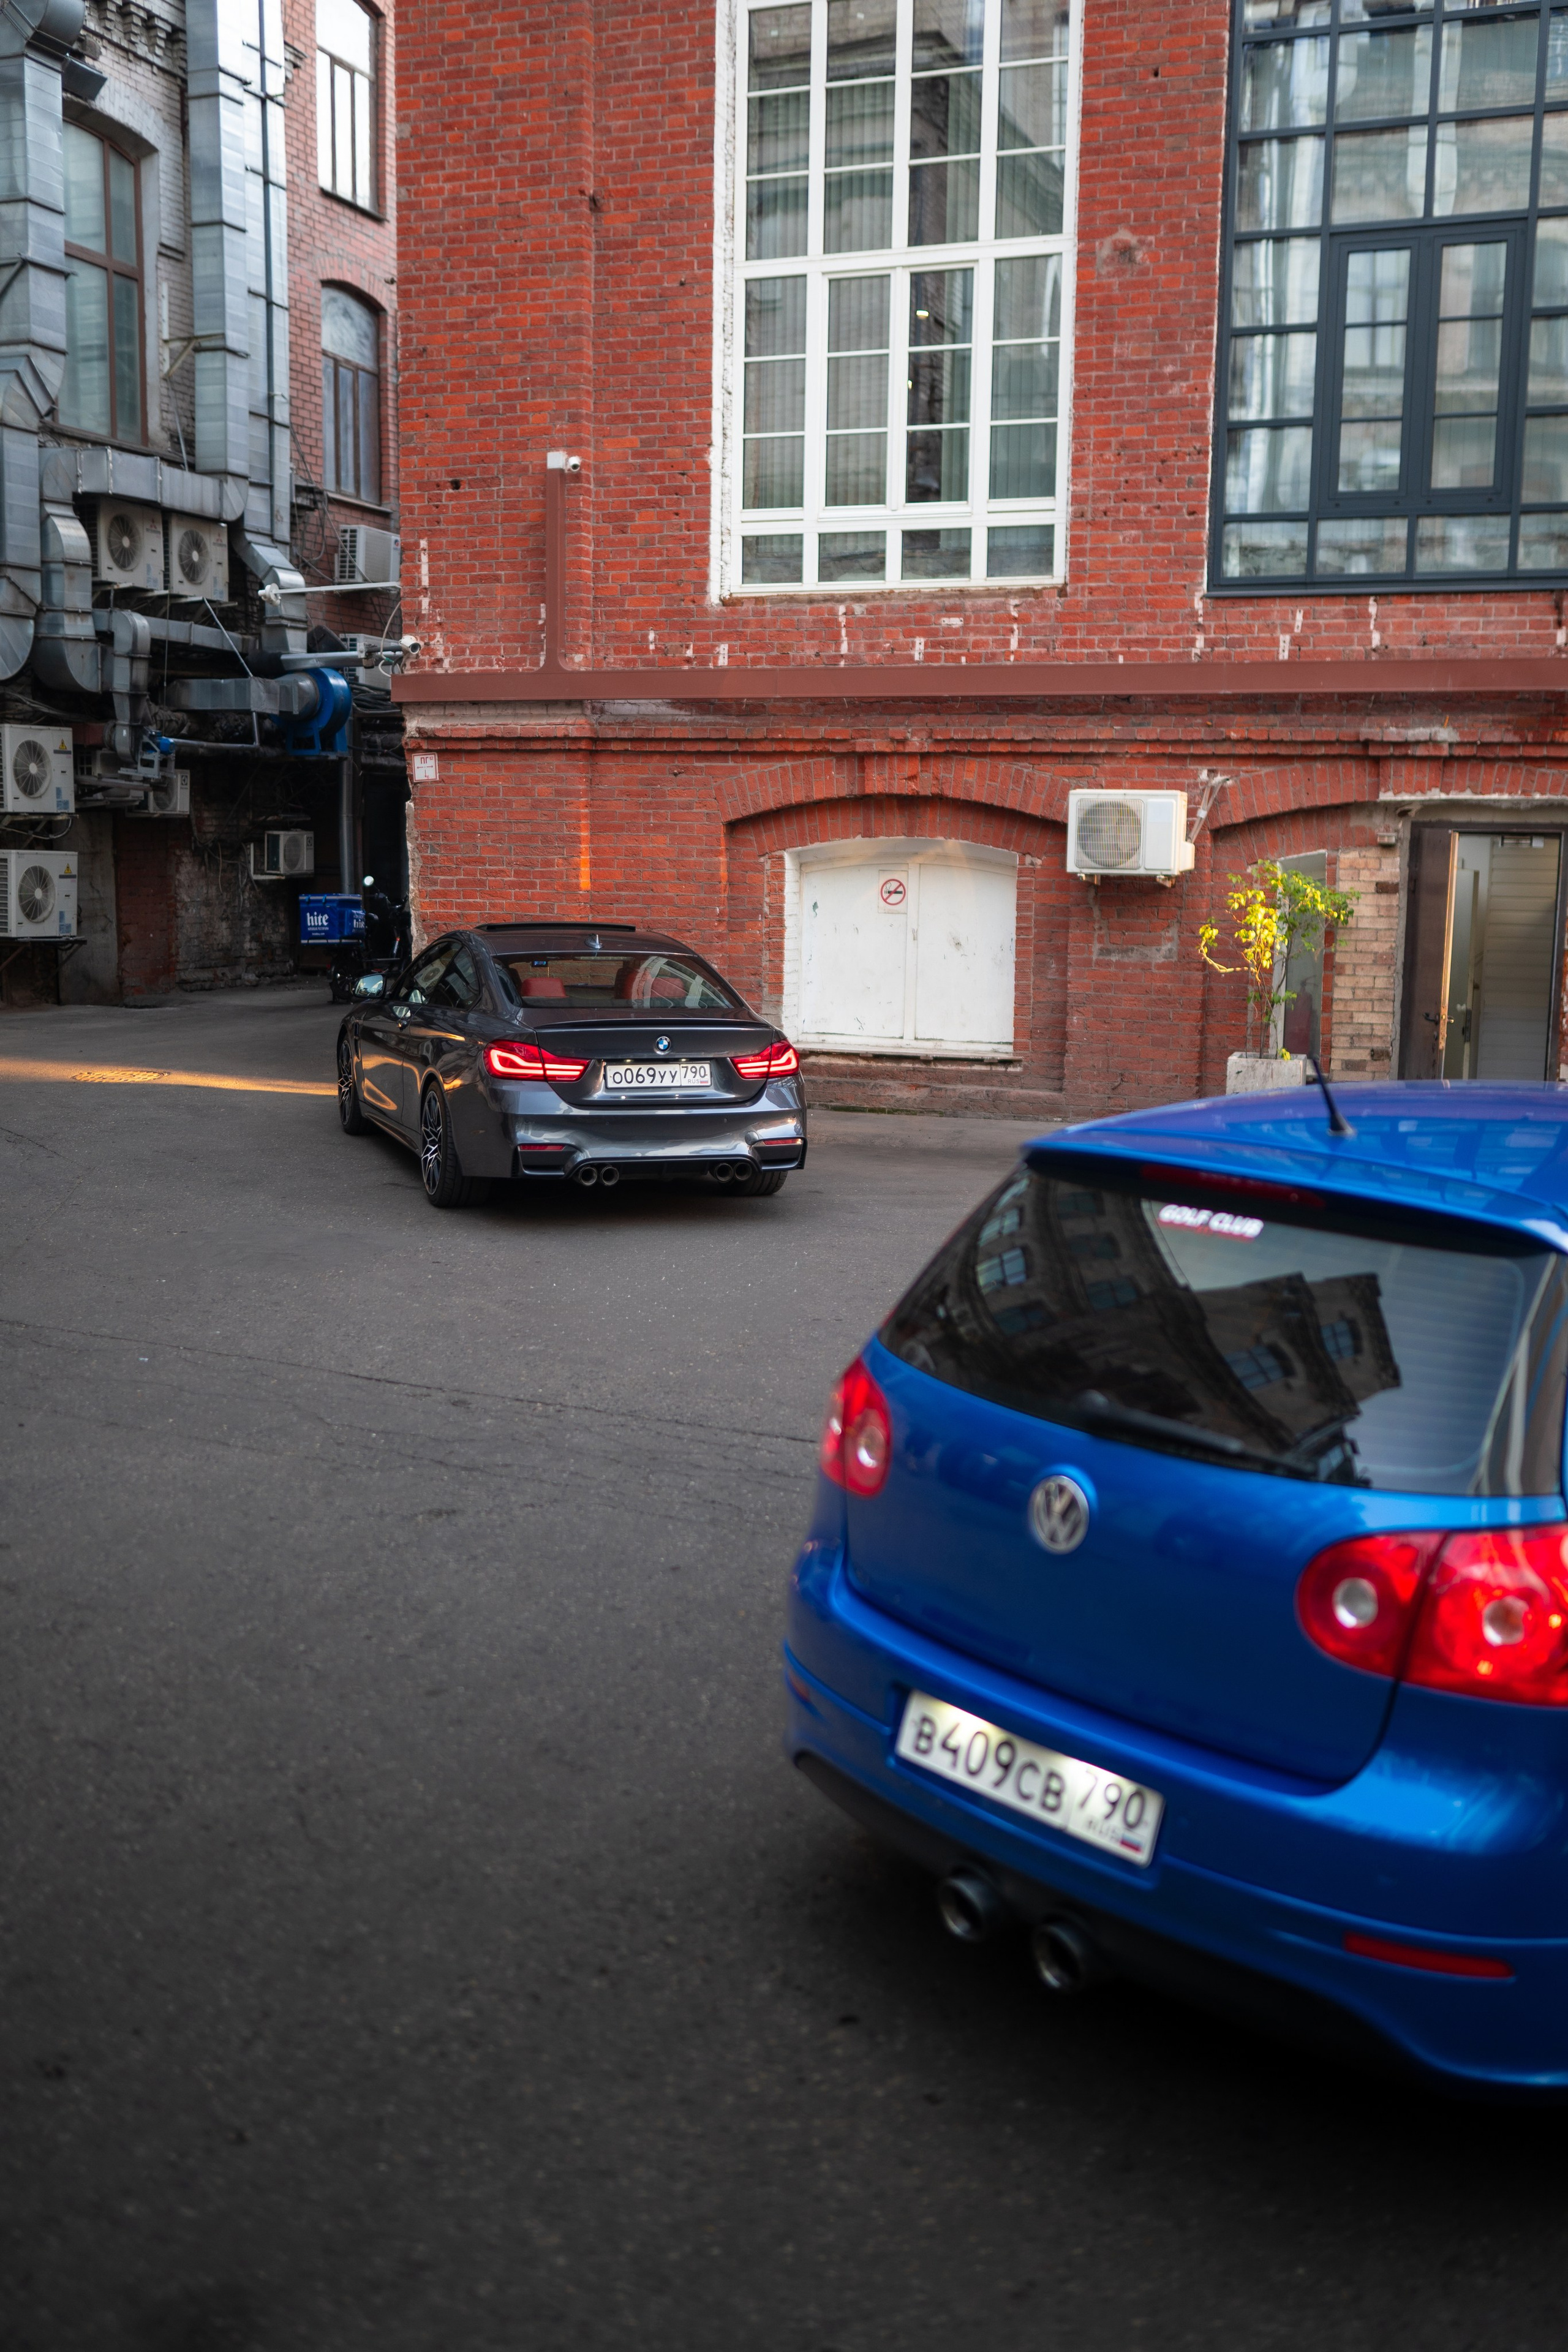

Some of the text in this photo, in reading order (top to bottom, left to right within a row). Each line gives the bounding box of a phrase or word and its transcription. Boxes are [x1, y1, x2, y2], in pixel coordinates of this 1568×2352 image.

[306, 911, 329, 926] hite
[681, 1065, 707, 1079] 790
[1079, 1768, 1145, 1830] 790
